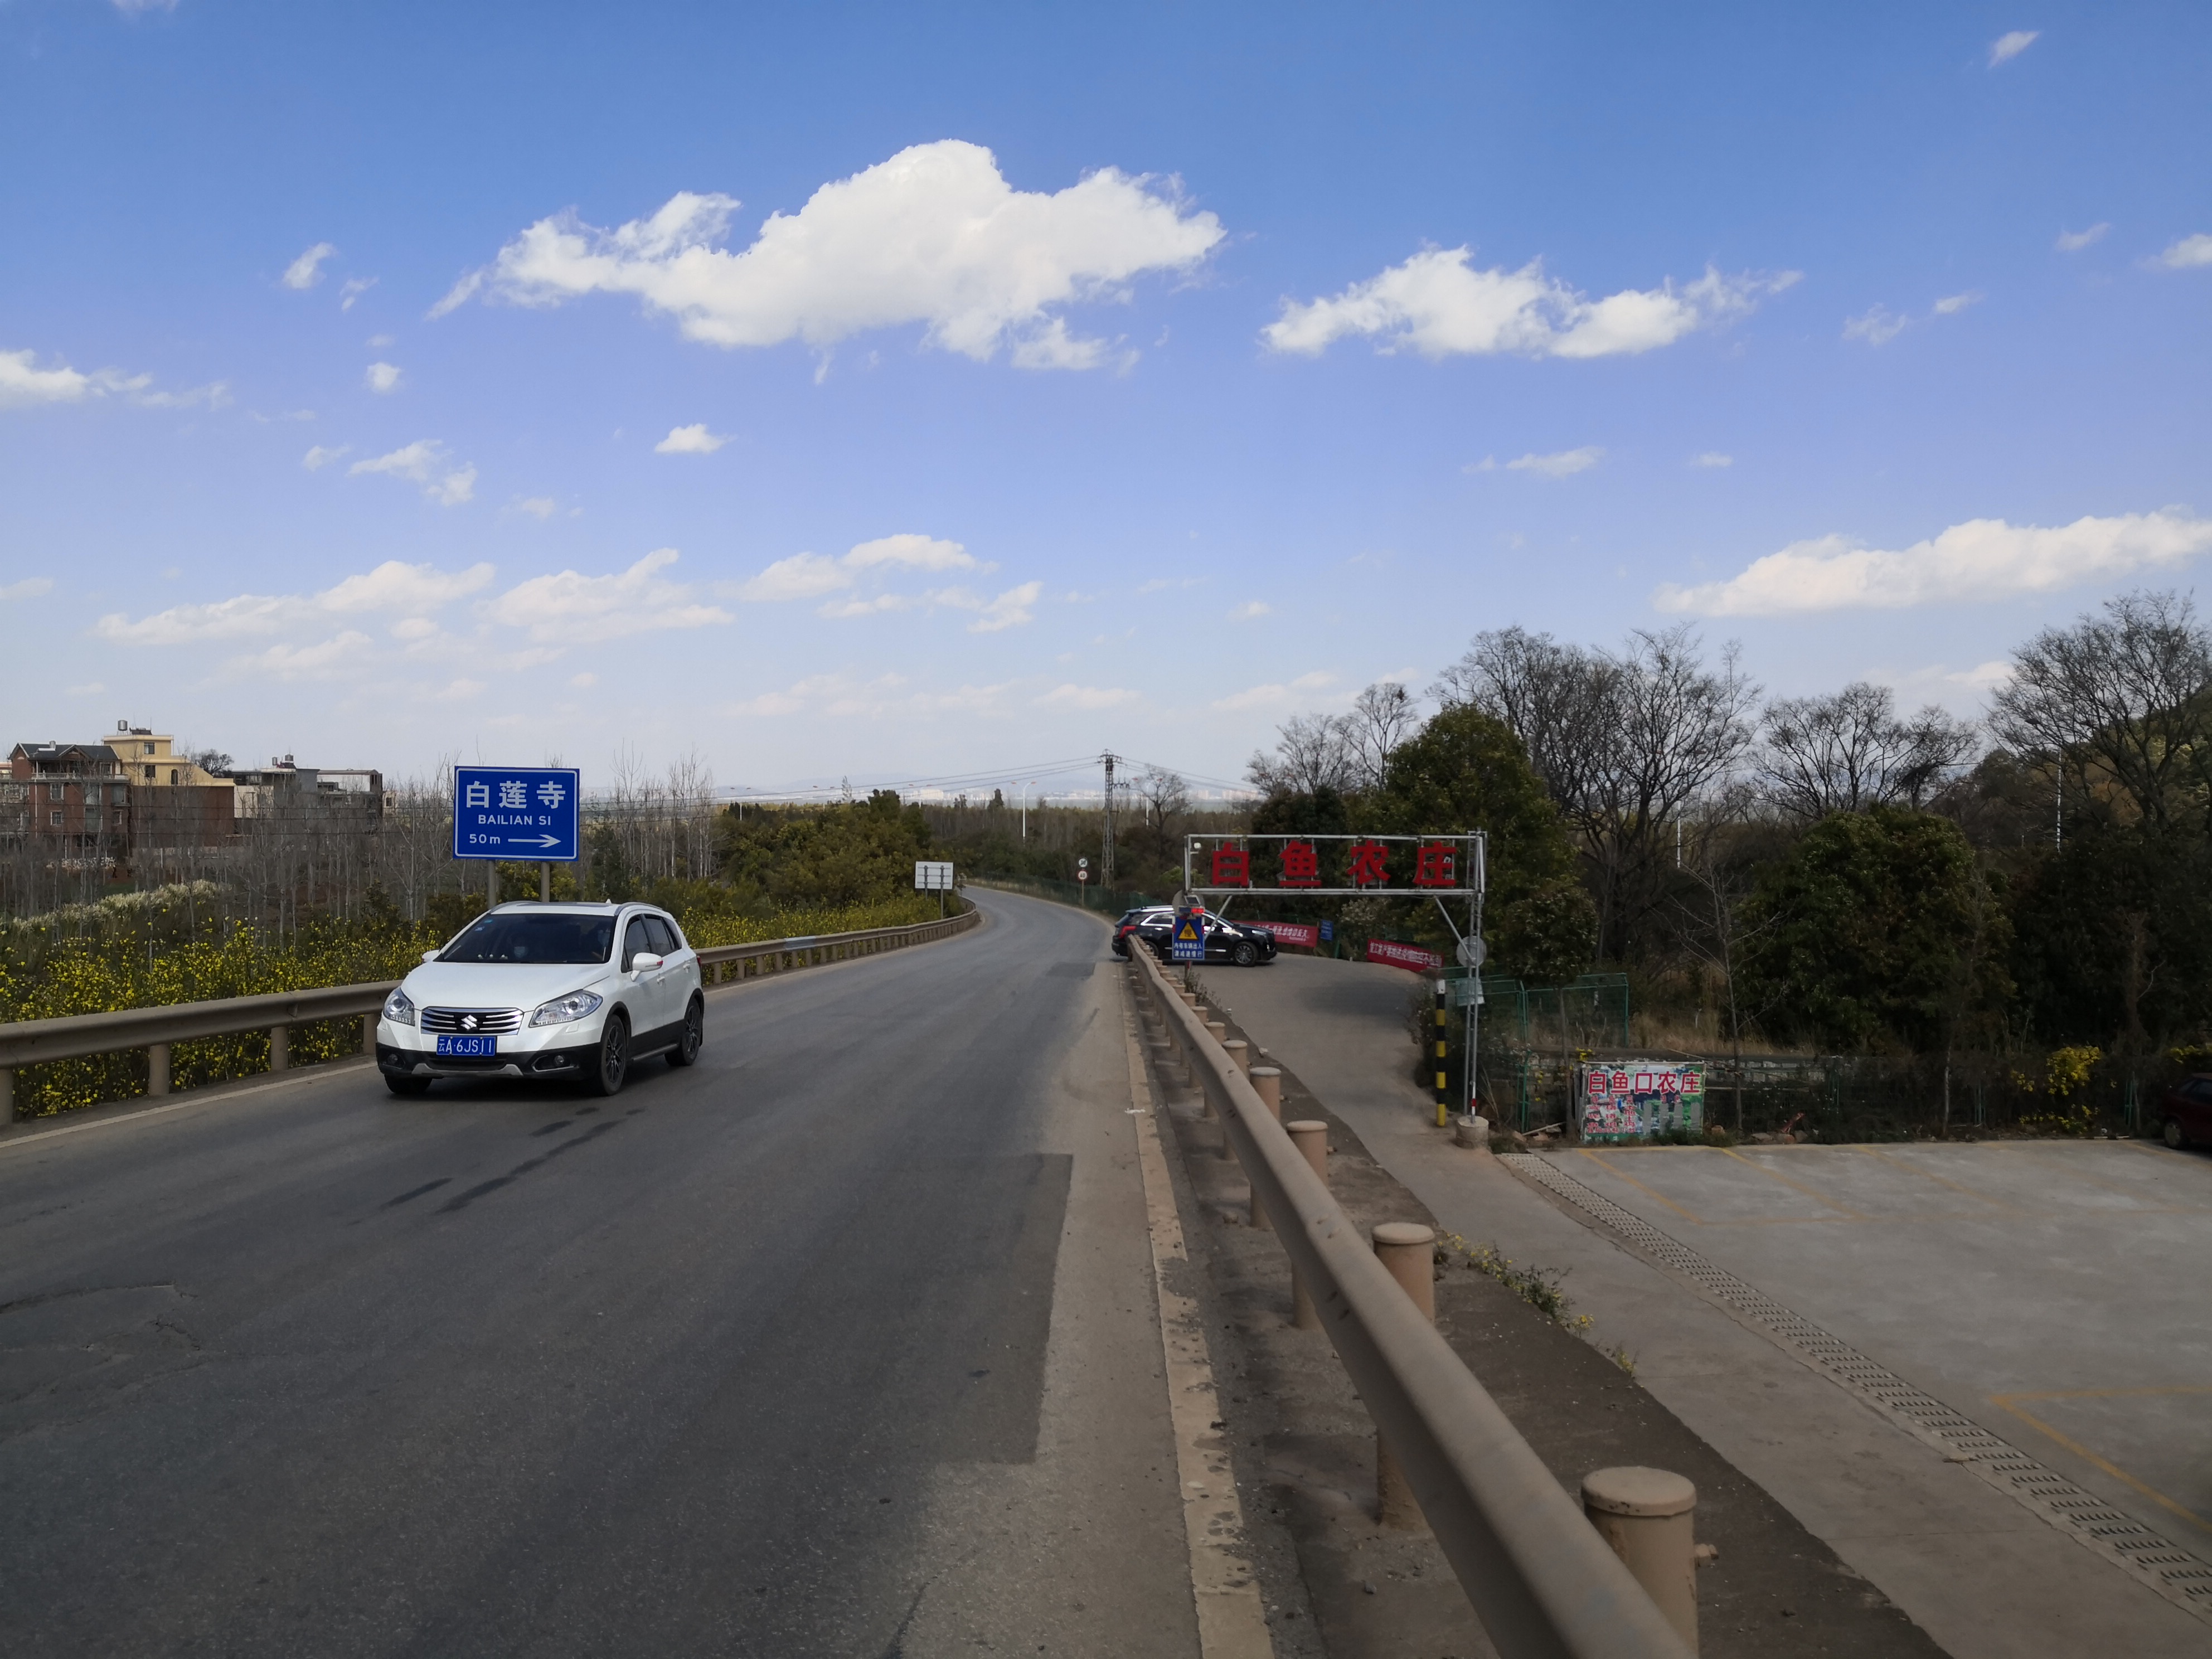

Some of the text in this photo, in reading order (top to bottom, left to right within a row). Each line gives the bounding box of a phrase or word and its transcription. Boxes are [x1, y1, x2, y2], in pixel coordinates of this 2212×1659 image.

[466, 780, 566, 809] 白莲寺
[478, 814, 551, 826] BAILIAN SI
[469, 834, 500, 845] 50m
[1211, 840, 1457, 886] 白鱼农庄
[1589, 1070, 1700, 1094] 白鱼口农庄
